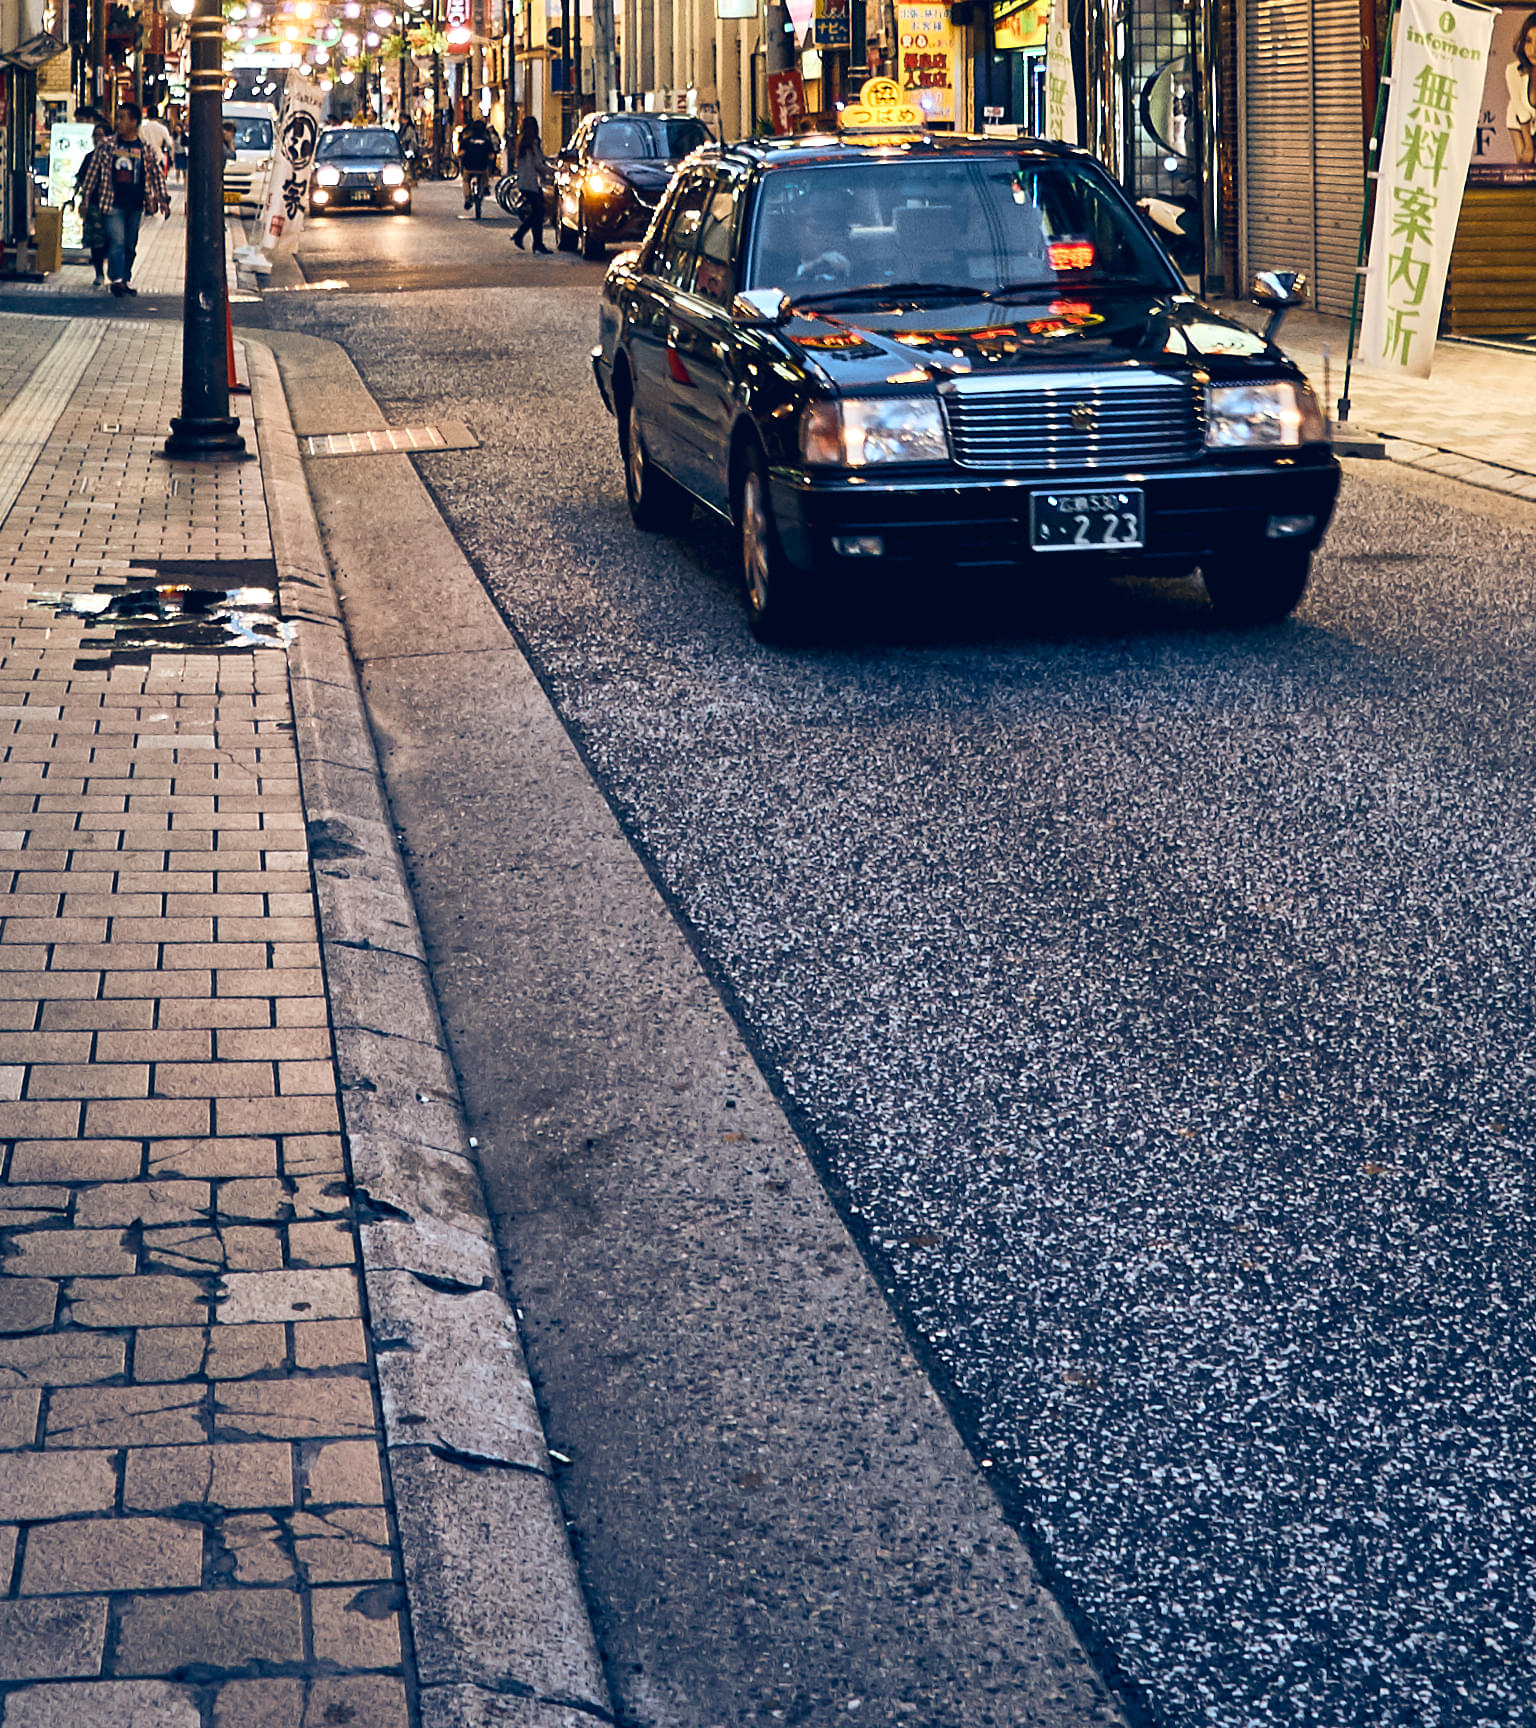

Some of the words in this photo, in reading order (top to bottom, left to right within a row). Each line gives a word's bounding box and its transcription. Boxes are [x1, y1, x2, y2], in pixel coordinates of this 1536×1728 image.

[1406, 25, 1481, 61] infomen
[853, 109, 916, 124] つばめ
[1382, 63, 1459, 367] 無料案内所
